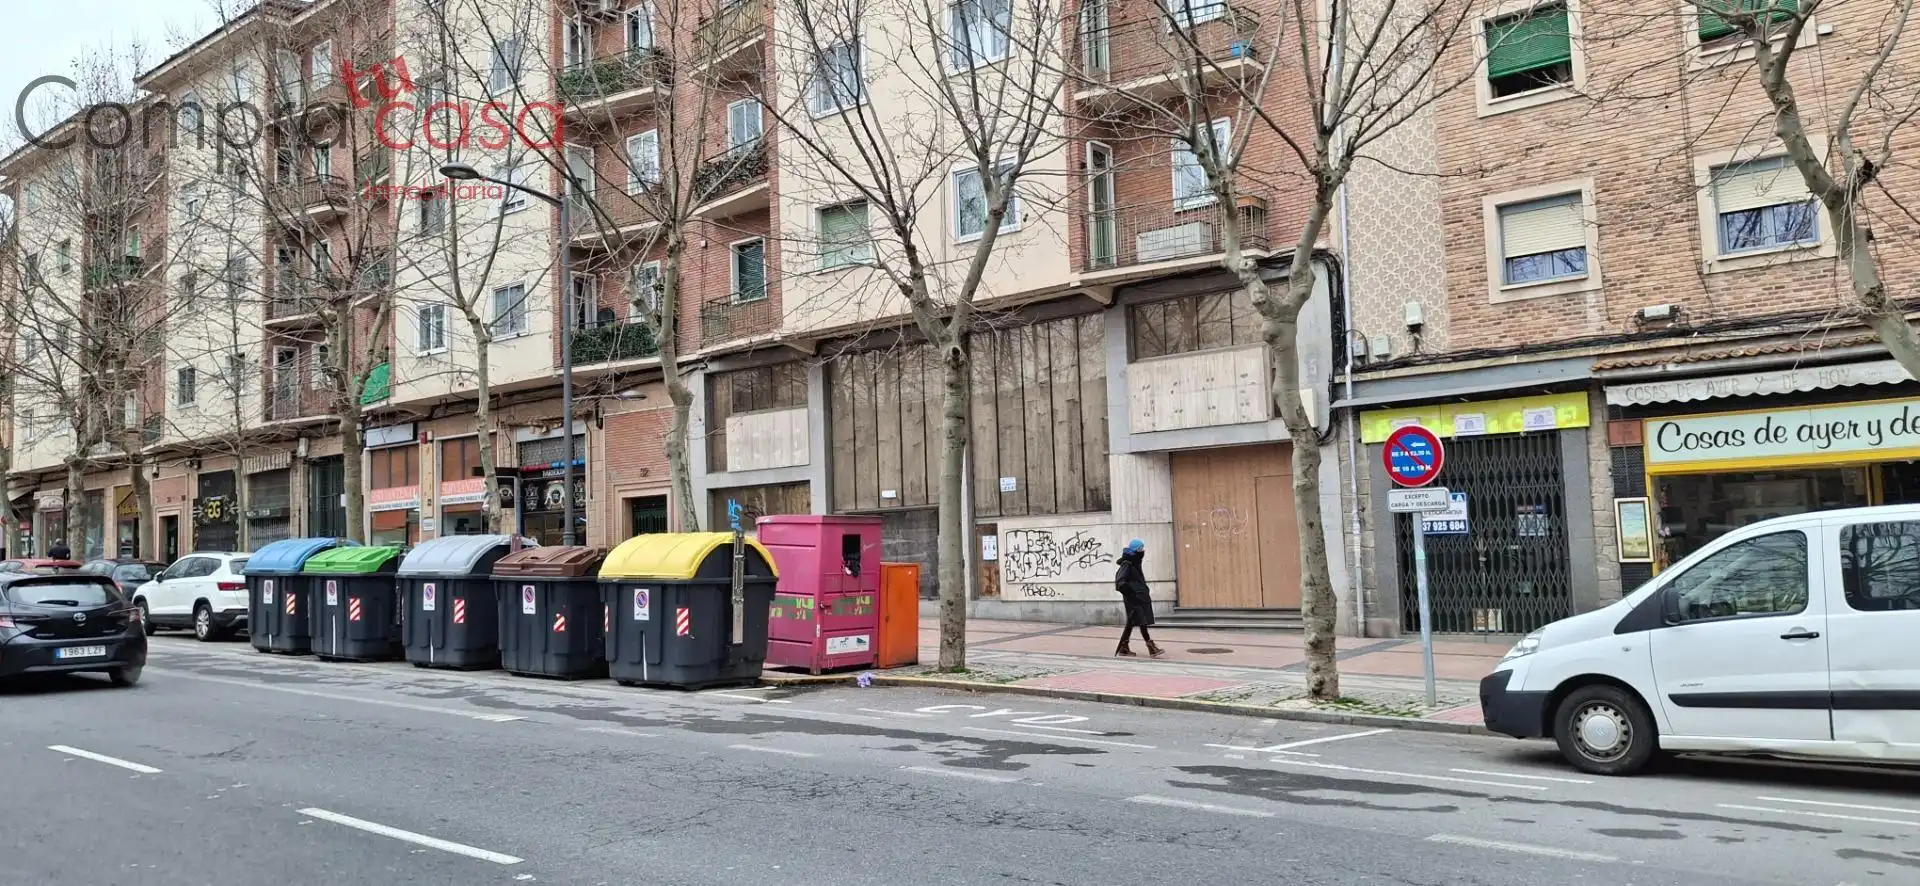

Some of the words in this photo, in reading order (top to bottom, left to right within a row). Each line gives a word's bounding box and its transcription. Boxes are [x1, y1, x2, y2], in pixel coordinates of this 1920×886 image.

[1656, 422, 1746, 452] Cosas
[1754, 416, 1788, 445] de
[1796, 420, 1862, 449] ayer
[1867, 419, 1884, 446] y
